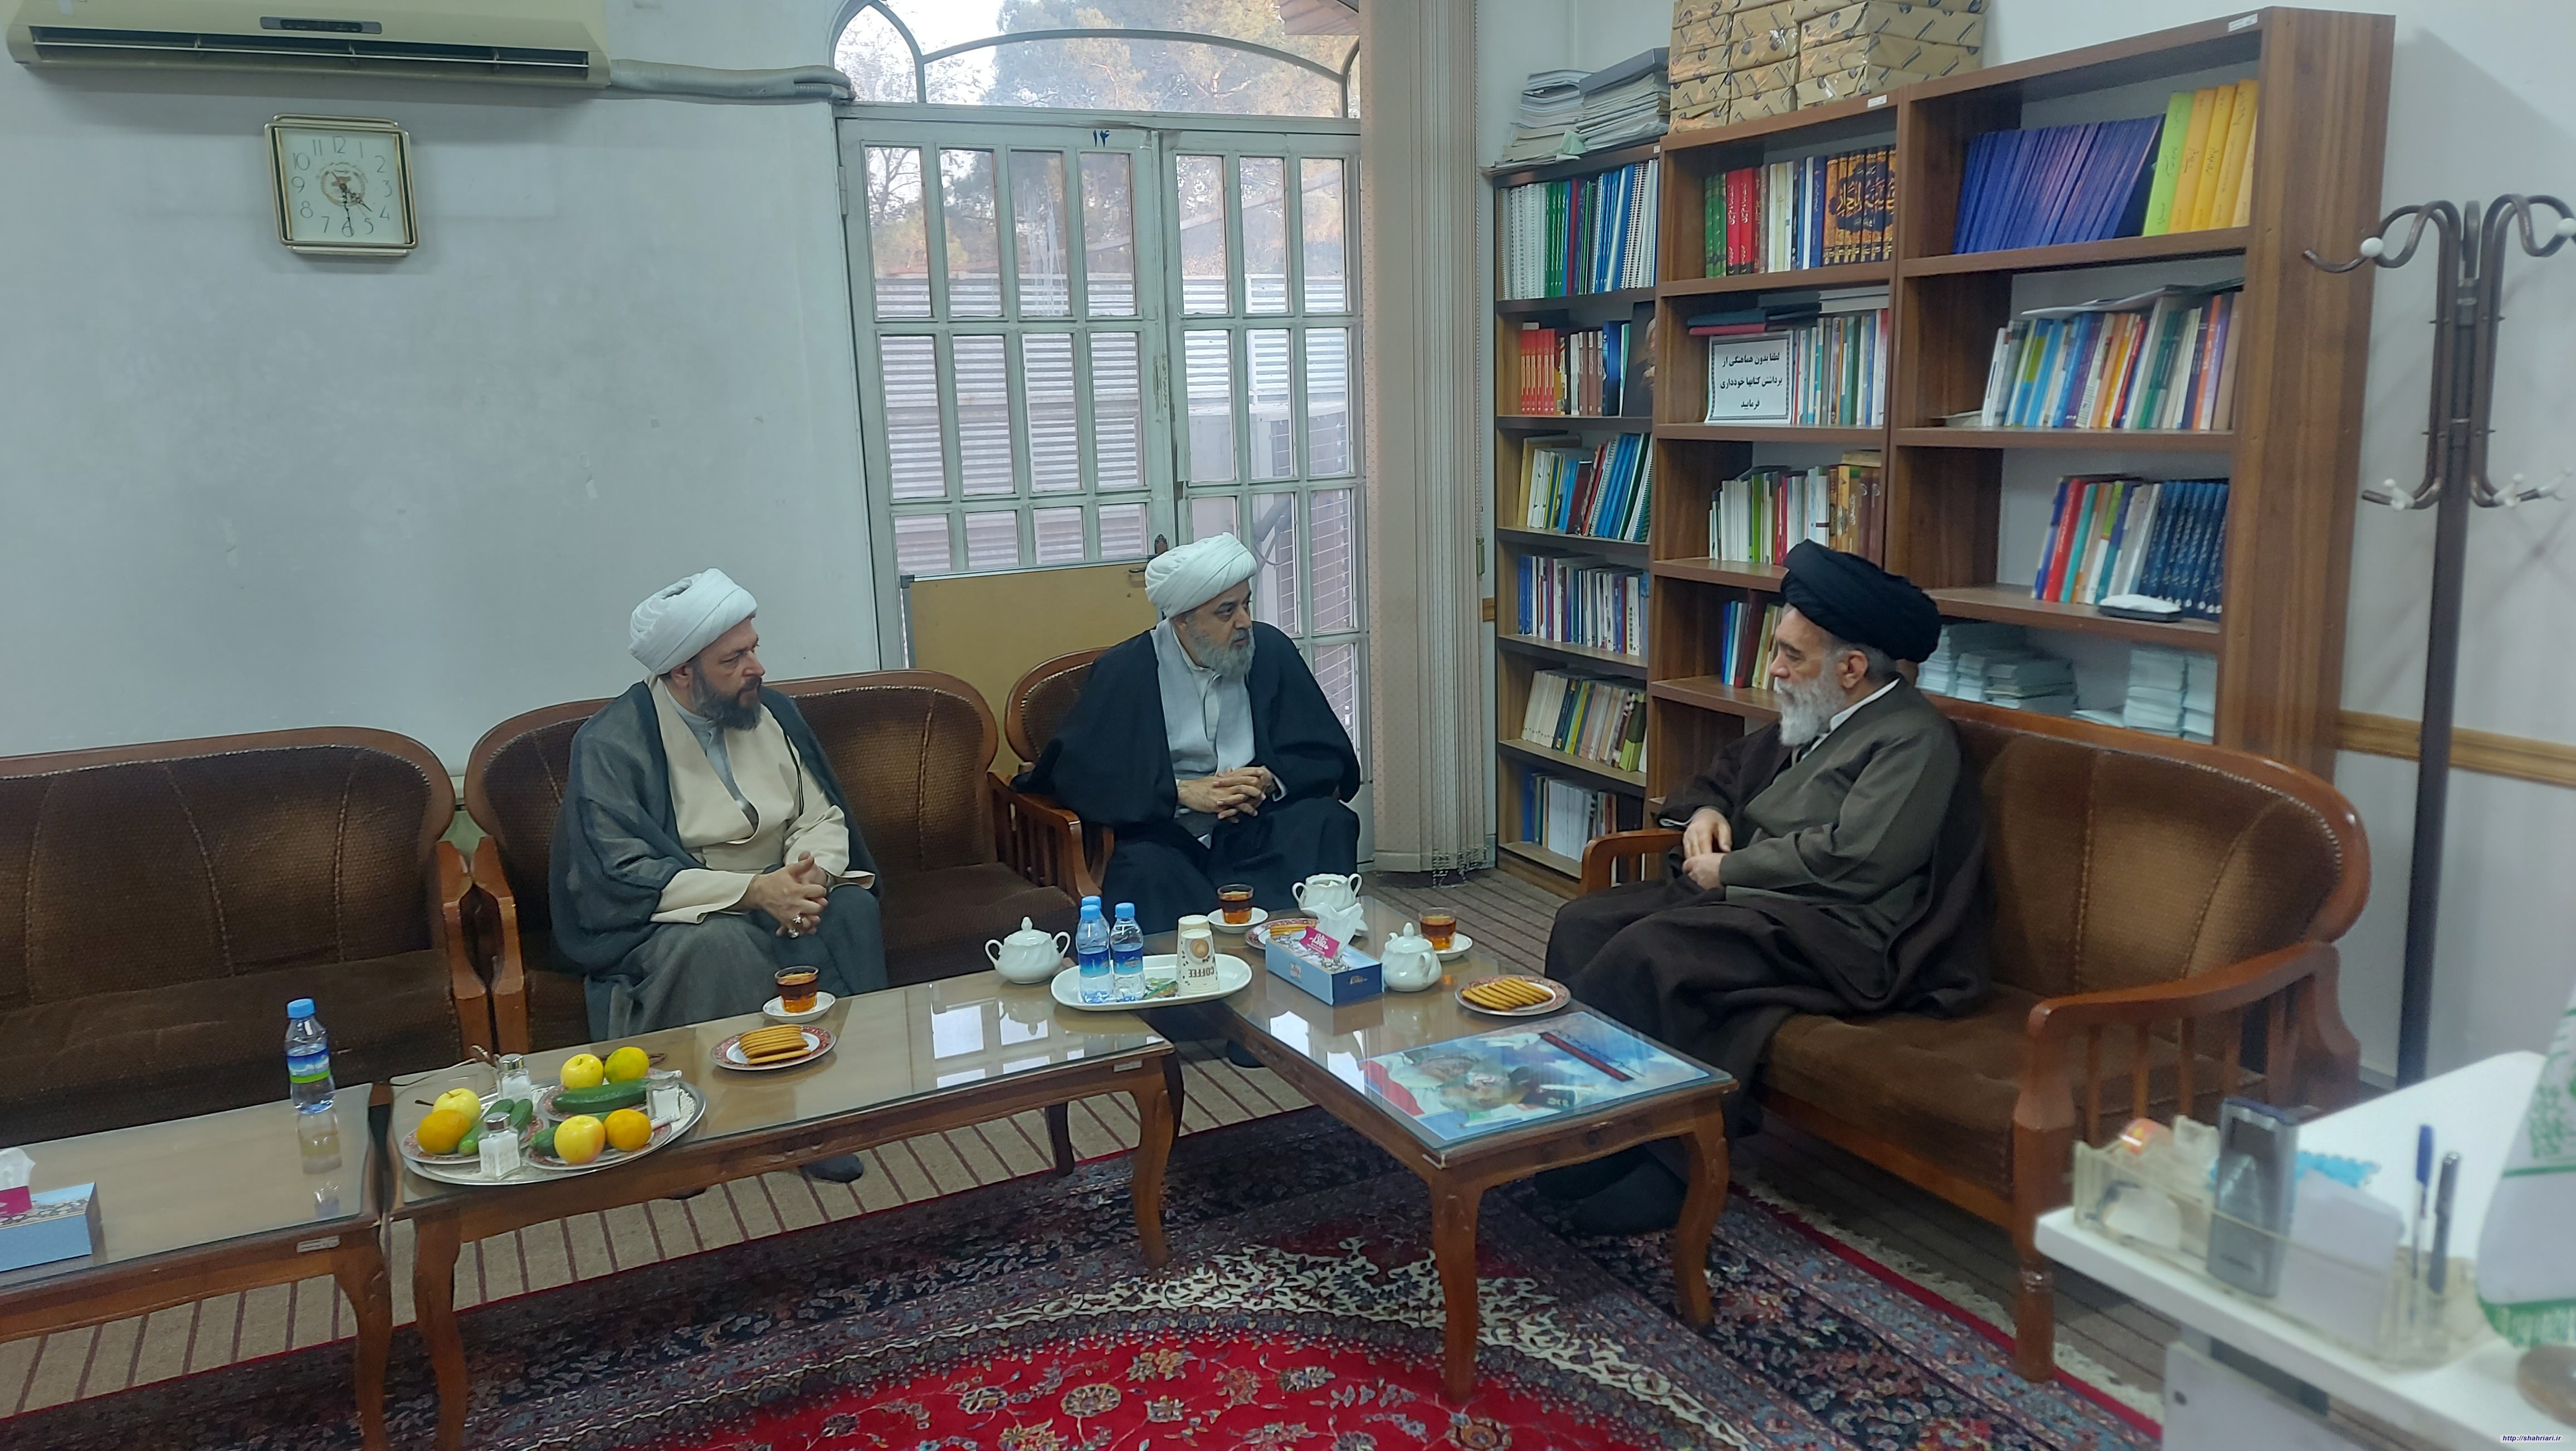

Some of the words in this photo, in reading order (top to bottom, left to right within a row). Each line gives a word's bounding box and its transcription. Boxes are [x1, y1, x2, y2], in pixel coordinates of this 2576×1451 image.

[313, 139, 323, 157] 11
[333, 135, 346, 154] 12
[359, 142, 364, 158] 1
[293, 153, 310, 171] 10
[374, 155, 386, 173] 2
[291, 176, 305, 194] 9
[383, 180, 393, 197] 3
[300, 201, 314, 219] 8
[379, 205, 390, 221] 4
[321, 216, 330, 233] 7
[341, 218, 355, 238] 6
[364, 217, 374, 235] 5
[1722, 356, 1728, 367] از
[1729, 354, 1754, 367] هماهنگی
[1754, 356, 1768, 365] بدون
[1769, 352, 1779, 361] لطفا
[1720, 377, 1745, 389] خودداری
[1746, 376, 1761, 387] کتابها
[1762, 376, 1783, 387] برداشتن
[1741, 398, 1760, 410] فرمایید
[1188, 966, 1215, 978] COFFEE
